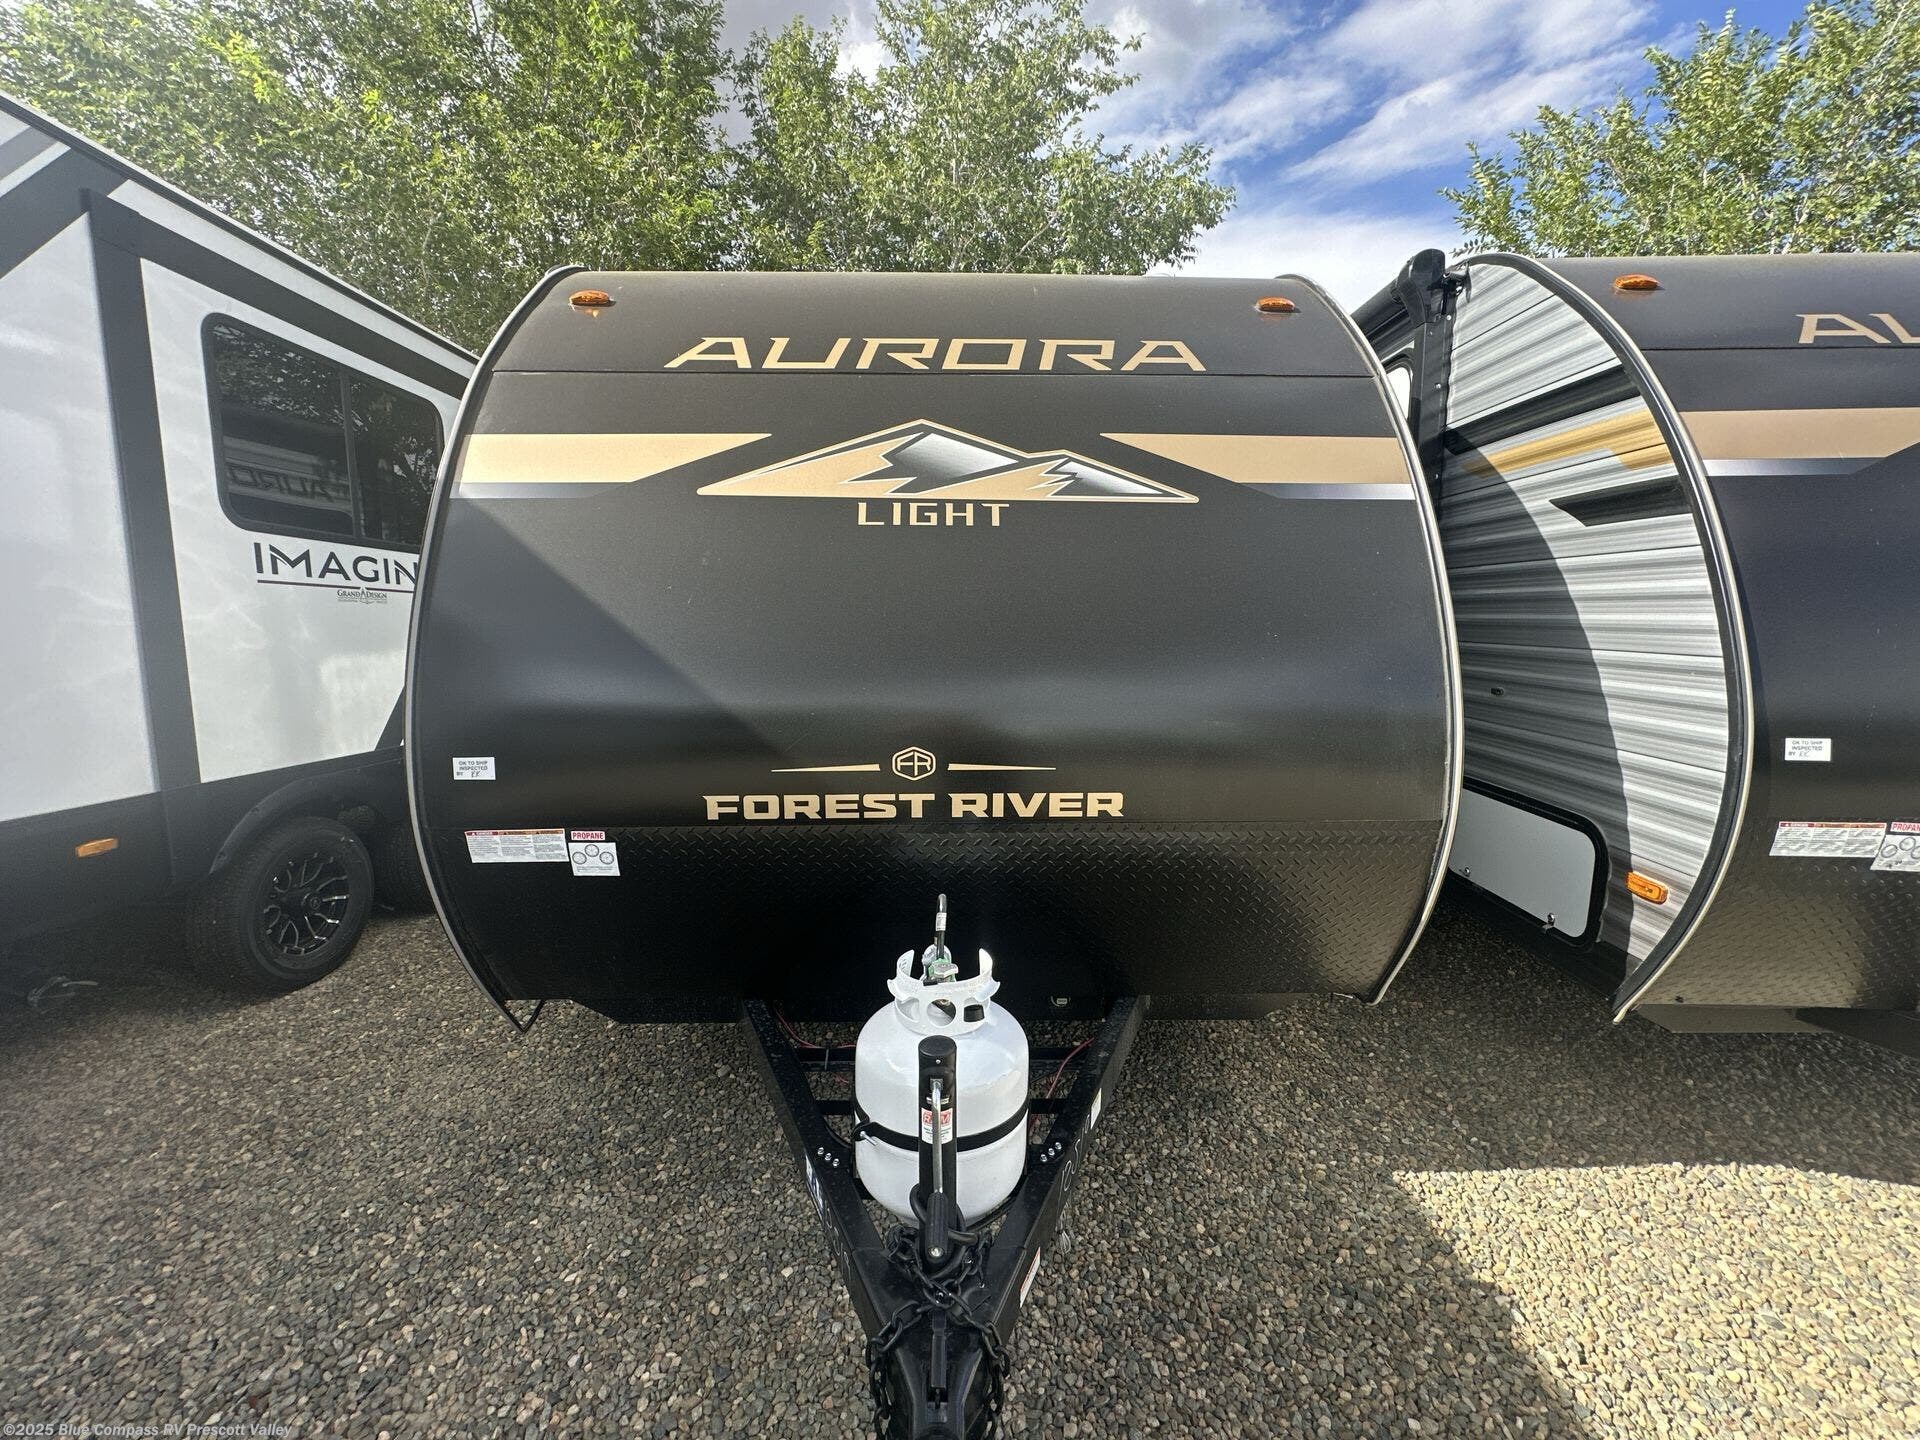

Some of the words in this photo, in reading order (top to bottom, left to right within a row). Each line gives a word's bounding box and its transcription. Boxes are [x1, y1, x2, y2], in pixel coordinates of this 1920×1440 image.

[663, 337, 1207, 371] AURORA
[858, 502, 1010, 526] LIGHT
[253, 542, 419, 585] IMAGIN
[702, 793, 935, 820] FOREST
[948, 792, 1124, 818] RIVER
[572, 832, 604, 840] PROPANE
